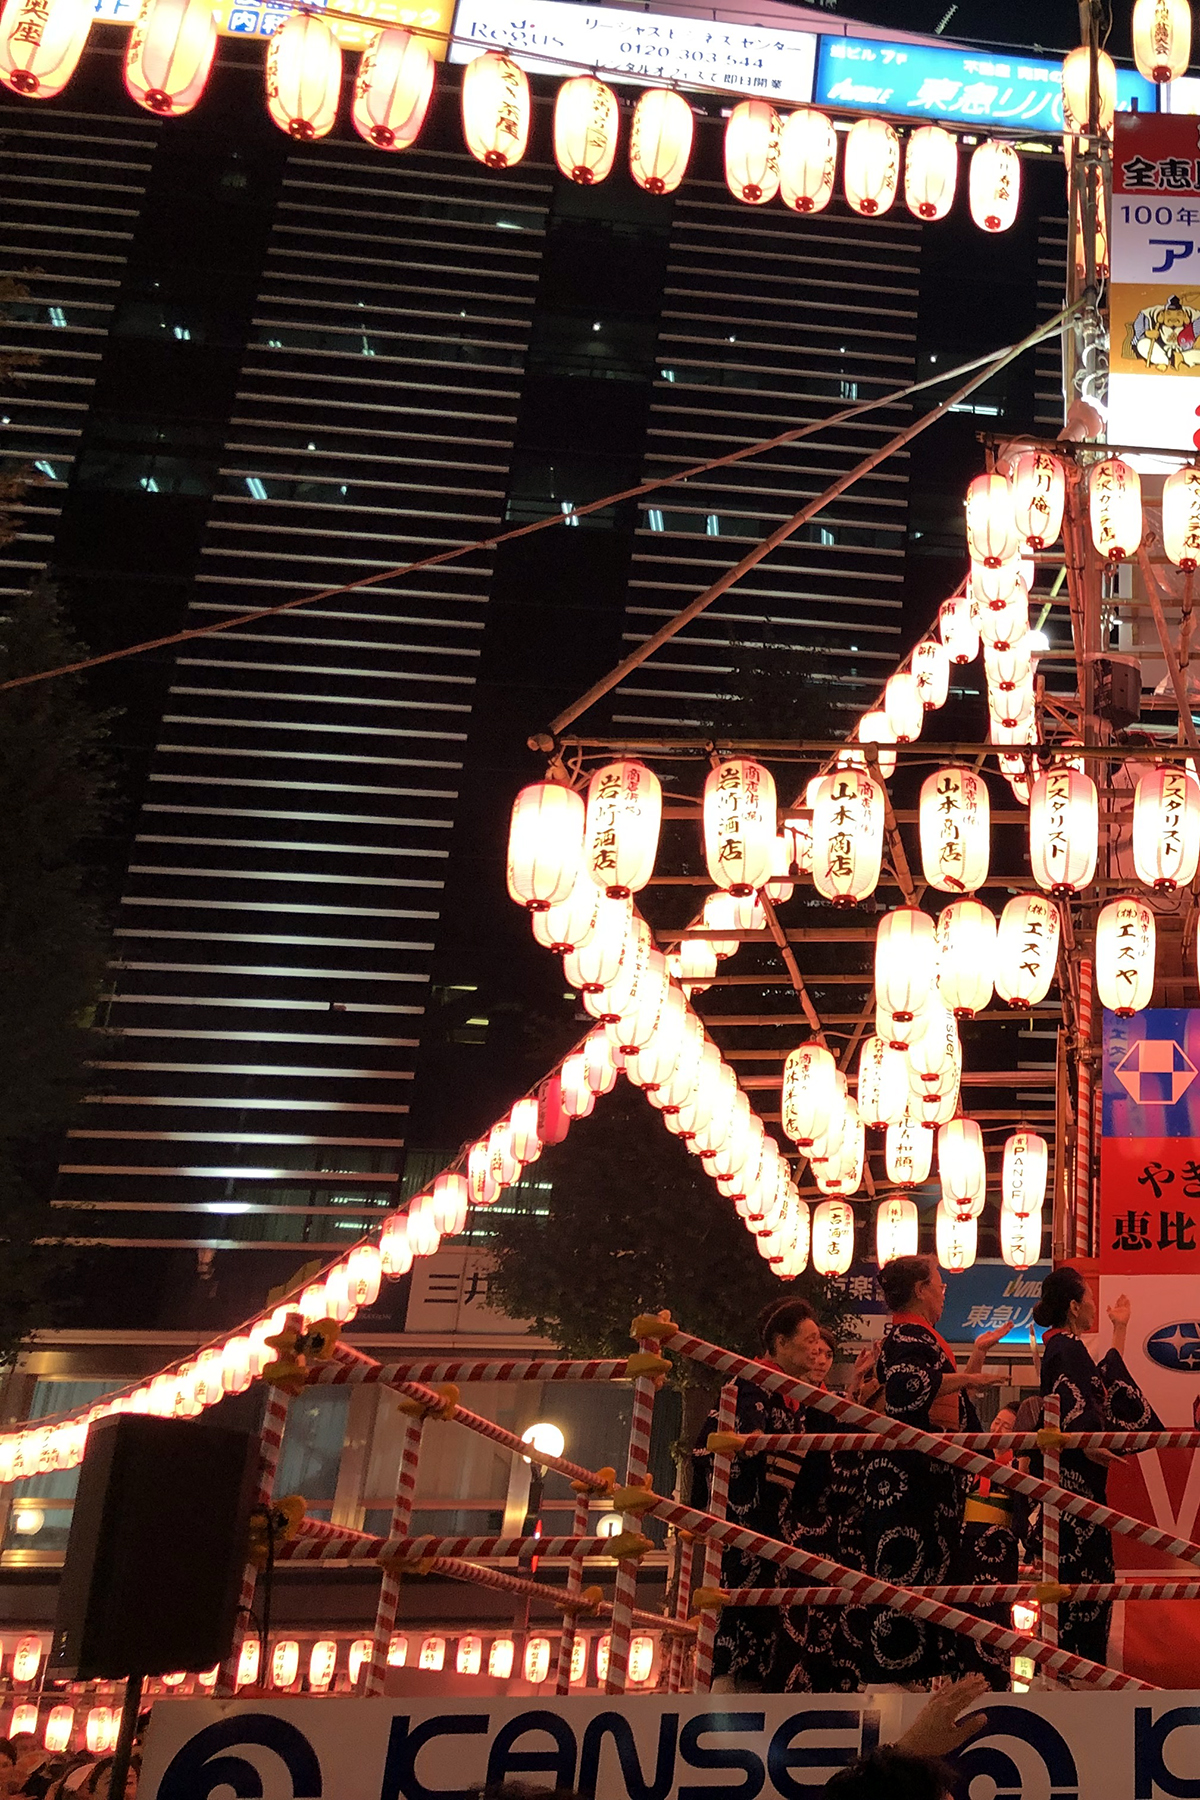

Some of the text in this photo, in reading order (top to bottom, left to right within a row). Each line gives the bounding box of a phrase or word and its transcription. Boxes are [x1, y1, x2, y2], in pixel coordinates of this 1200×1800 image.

[826, 782, 857, 878] 山本商店
[937, 777, 962, 863] 山本商店
[1046, 774, 1068, 859] アスタリスト
[1161, 774, 1186, 856] アスタリスト
[962, 1304, 1036, 1329] 東急リ
